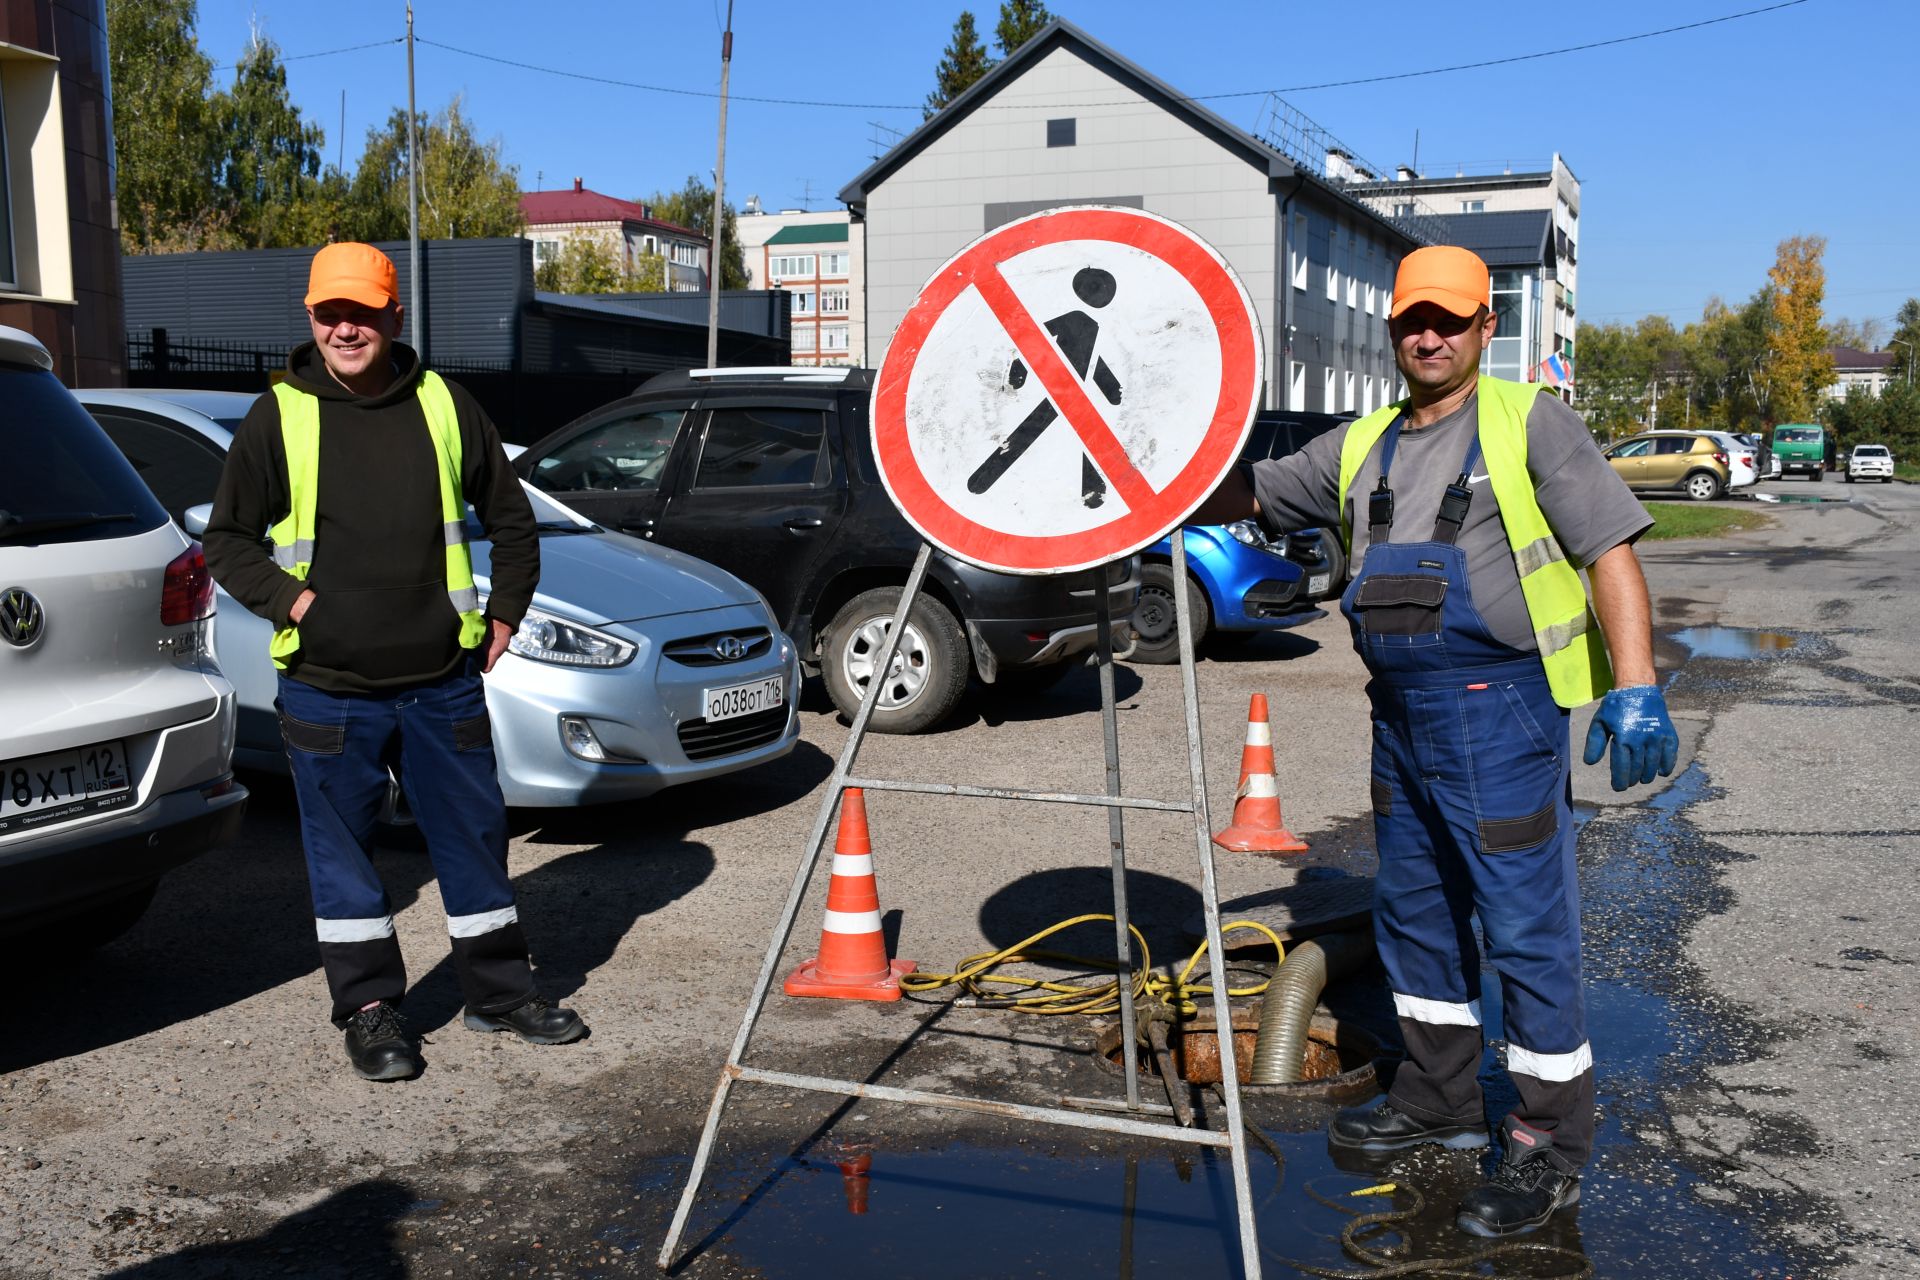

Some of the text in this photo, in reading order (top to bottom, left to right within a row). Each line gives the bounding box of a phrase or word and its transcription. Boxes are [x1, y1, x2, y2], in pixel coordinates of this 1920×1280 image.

[764, 679, 781, 700] 716
[86, 748, 116, 780] 12
[87, 780, 109, 793] RUS
